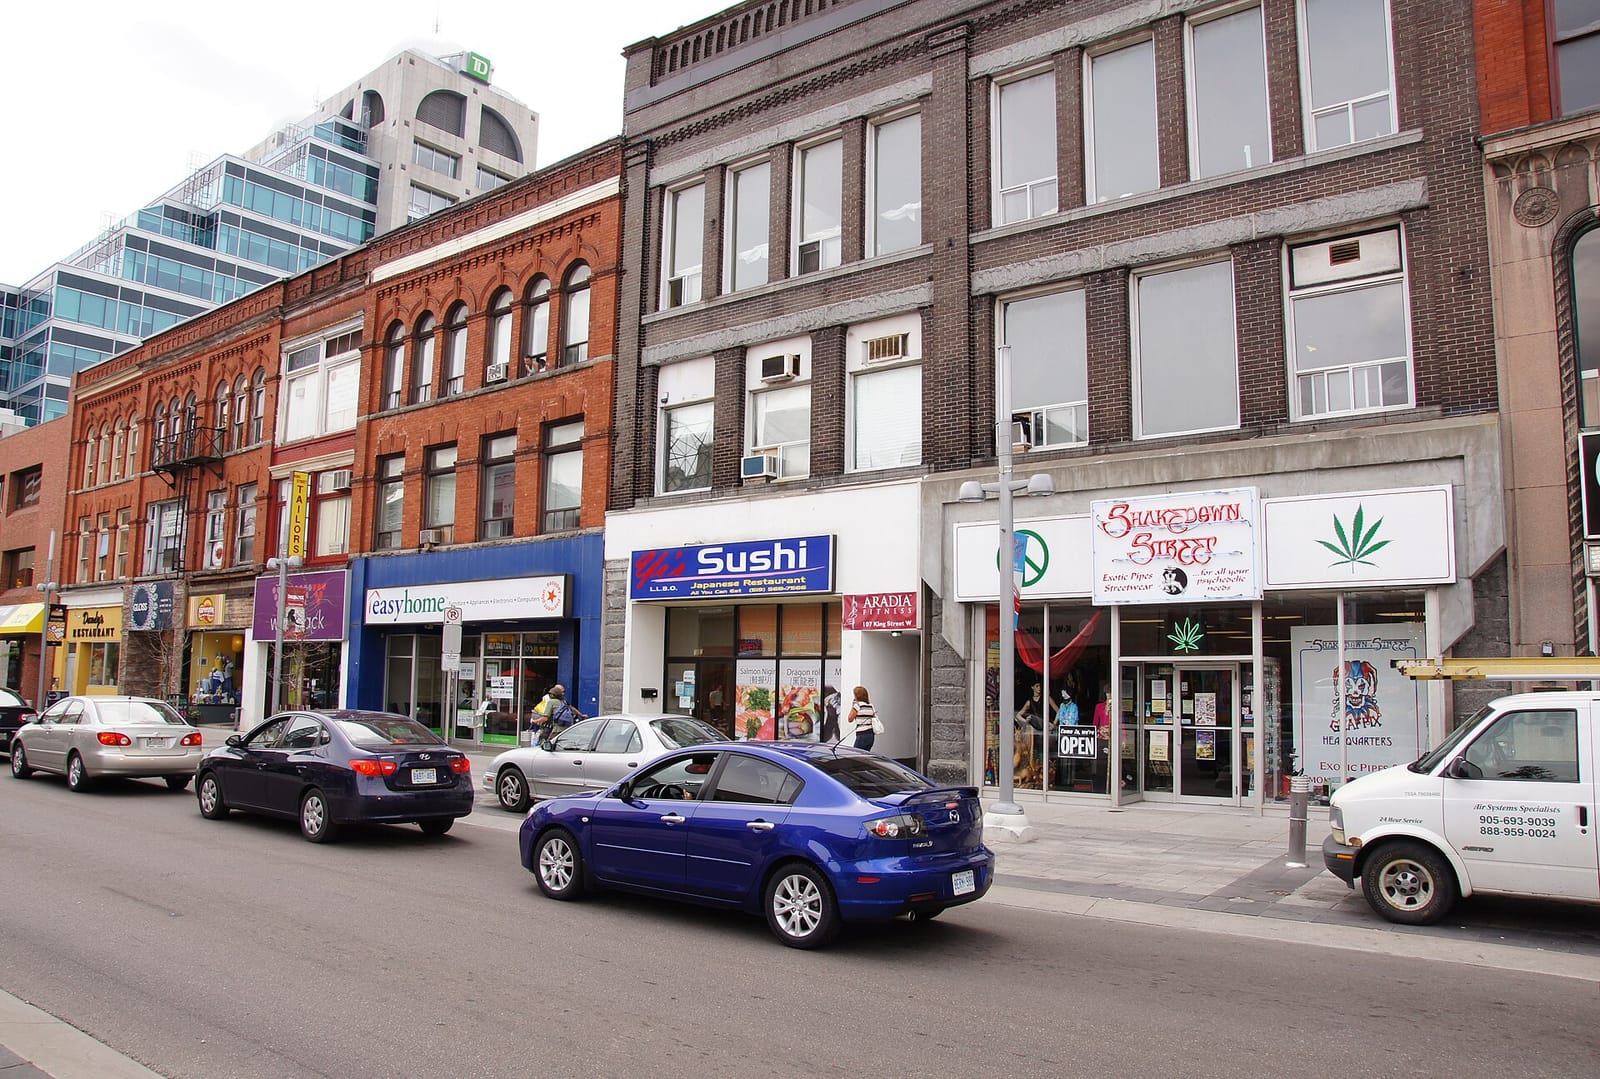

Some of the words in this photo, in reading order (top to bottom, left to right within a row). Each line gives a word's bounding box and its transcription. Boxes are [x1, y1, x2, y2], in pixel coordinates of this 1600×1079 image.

[471, 56, 488, 75] TD
[292, 485, 304, 553] TAILORS
[1101, 503, 1241, 538] SHAKEDOWN
[1127, 532, 1218, 565] STREET
[697, 540, 807, 575] Sushi
[1102, 573, 1129, 582] Exotic
[1130, 572, 1153, 582] Pipes
[1214, 567, 1226, 576] all
[1228, 568, 1250, 578] your
[690, 581, 740, 590] Japanese
[743, 576, 807, 586] Restaurant
[1197, 575, 1246, 585] psychedelic
[1104, 583, 1153, 593] Streetwear
[133, 602, 148, 612] GLOSS
[372, 589, 445, 622] easyhome
[862, 594, 912, 609] ARADIA
[862, 607, 912, 615] FITNESS
[73, 627, 115, 638] RESTAURANT
[786, 668, 808, 677] Dragon
[1060, 736, 1095, 755] OPEN
[1322, 735, 1393, 747] HEAQUARTERS
[1320, 761, 1358, 772] EXOIC
[1473, 803, 1486, 811] Air
[1487, 804, 1518, 813] Systems
[1519, 804, 1561, 813] Specialists
[1479, 815, 1556, 827] 905-693-9039
[1479, 826, 1557, 838] 888-959-0024
